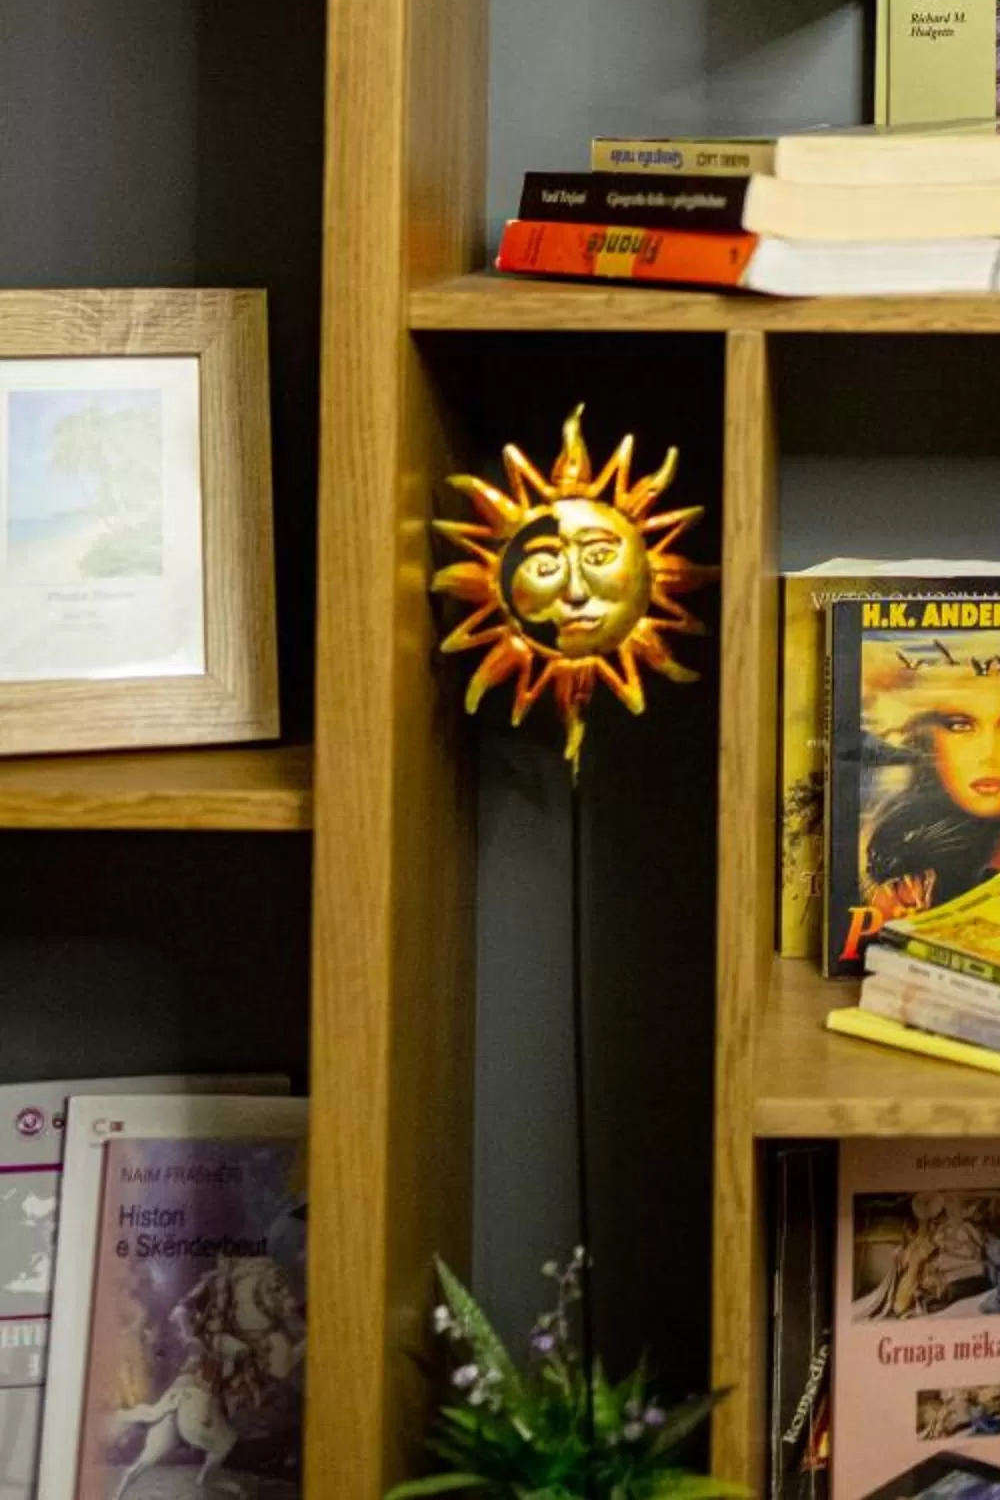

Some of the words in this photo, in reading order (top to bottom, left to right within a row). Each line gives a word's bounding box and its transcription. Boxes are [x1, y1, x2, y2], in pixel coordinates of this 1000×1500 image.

[911, 12, 951, 24] Richard
[862, 603, 916, 627] H.K.
[120, 1165, 162, 1184] NAIM
[116, 1239, 129, 1258] e
[877, 1335, 946, 1368] Gruaja
